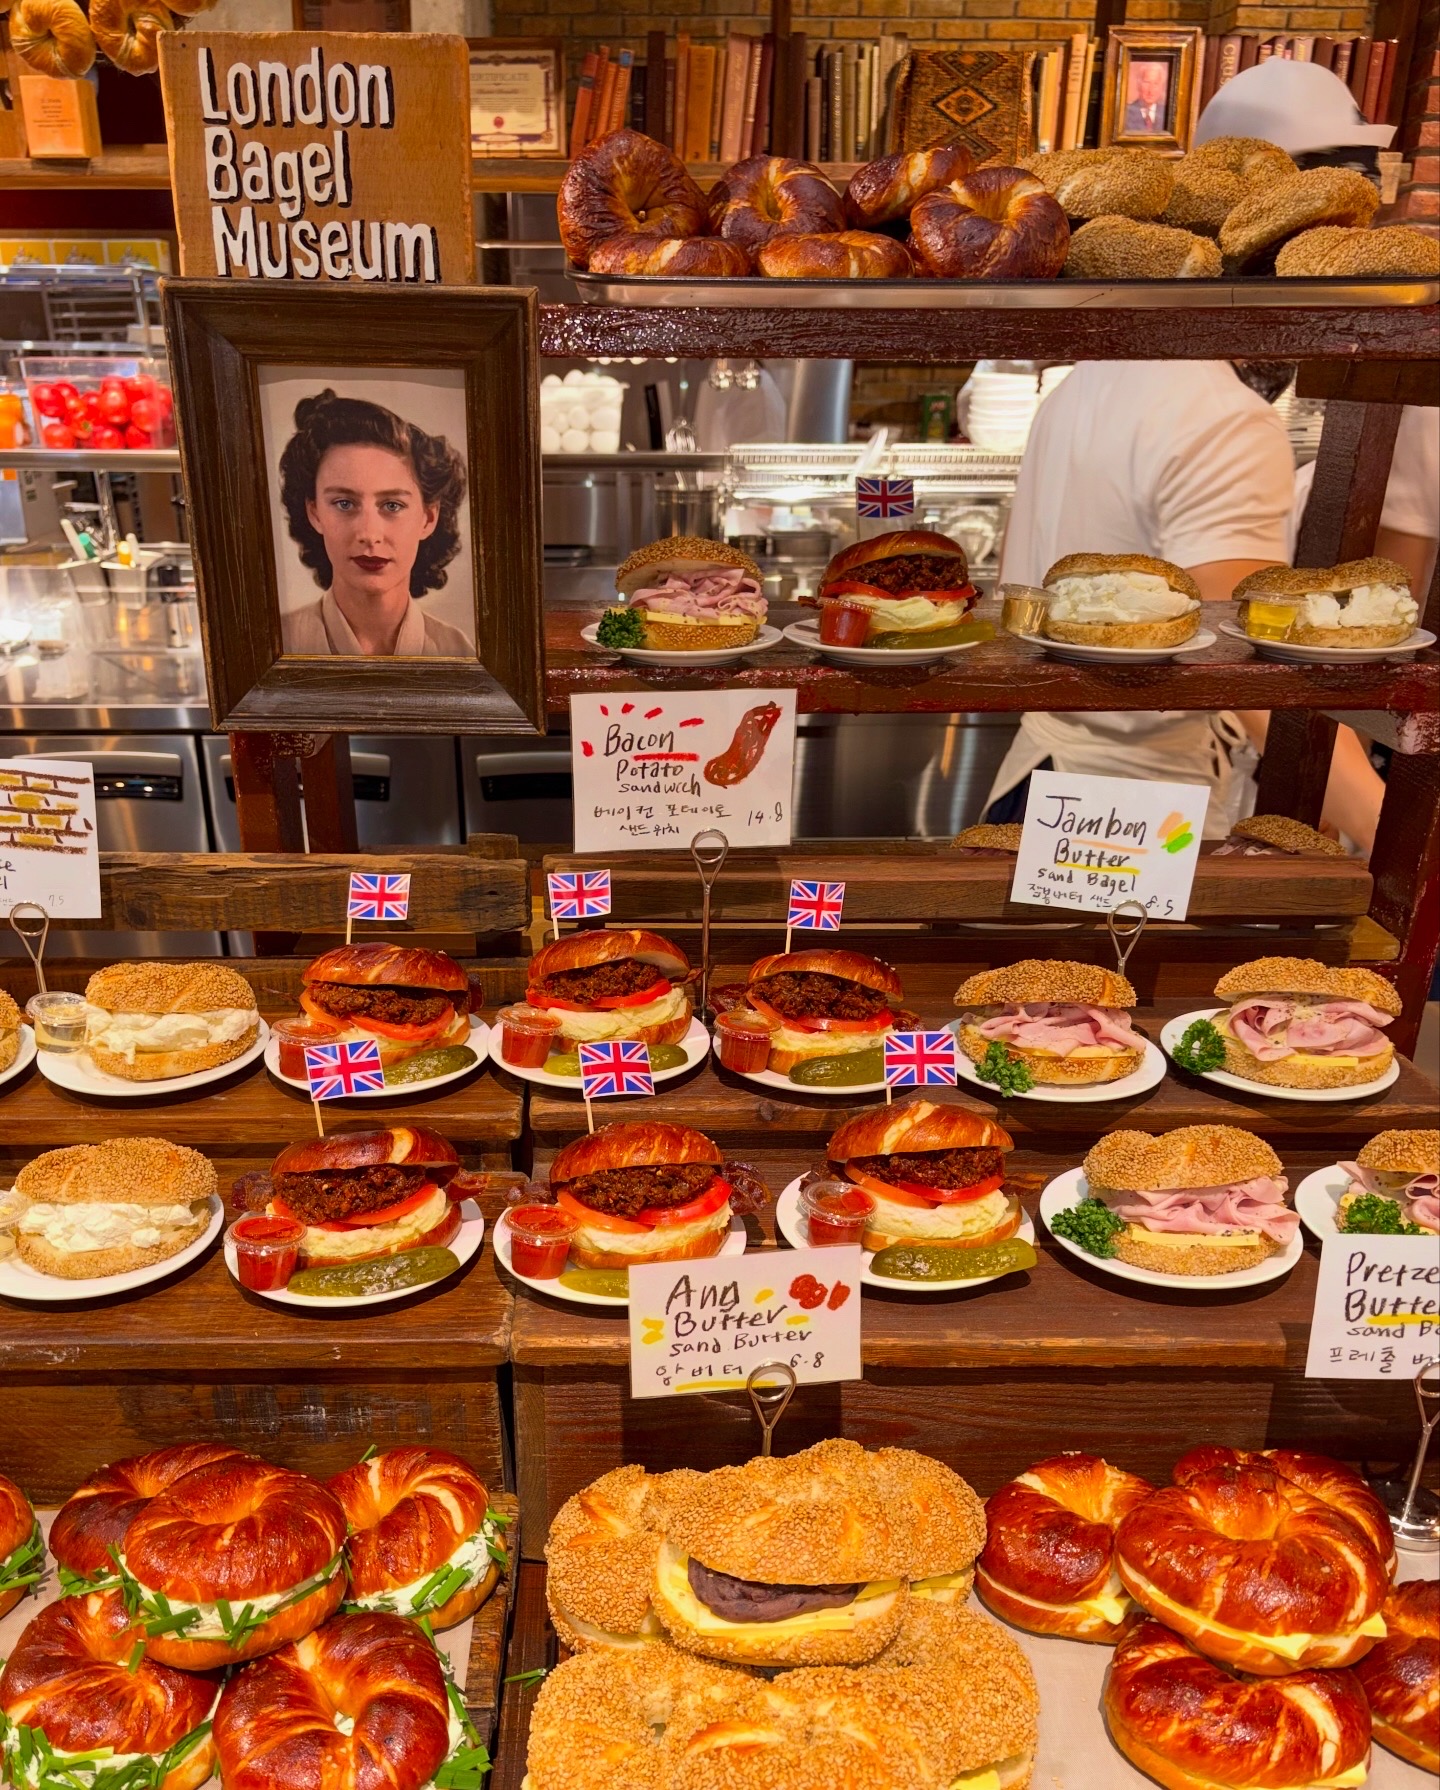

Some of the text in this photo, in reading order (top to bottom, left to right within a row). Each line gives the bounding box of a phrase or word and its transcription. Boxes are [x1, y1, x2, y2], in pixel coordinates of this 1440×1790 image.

[198, 47, 395, 129] London
[471, 72, 531, 82] ERTIFICATE
[204, 127, 352, 221] Bagel
[212, 206, 442, 284] Museum
[603, 724, 675, 757] Bacon
[616, 759, 684, 782] Potato
[594, 805, 655, 820] 베이컨
[748, 802, 783, 827] 14.8
[1037, 795, 1147, 846] Jambon
[619, 823, 680, 836] 샌드위치
[1054, 838, 1130, 868] Butter
[1087, 872, 1136, 896] Bagel
[1145, 896, 1174, 916] 8.5
[665, 1275, 740, 1315] Ang
[674, 1305, 788, 1338] Butter
[1330, 1346, 1396, 1373] 프레츨
